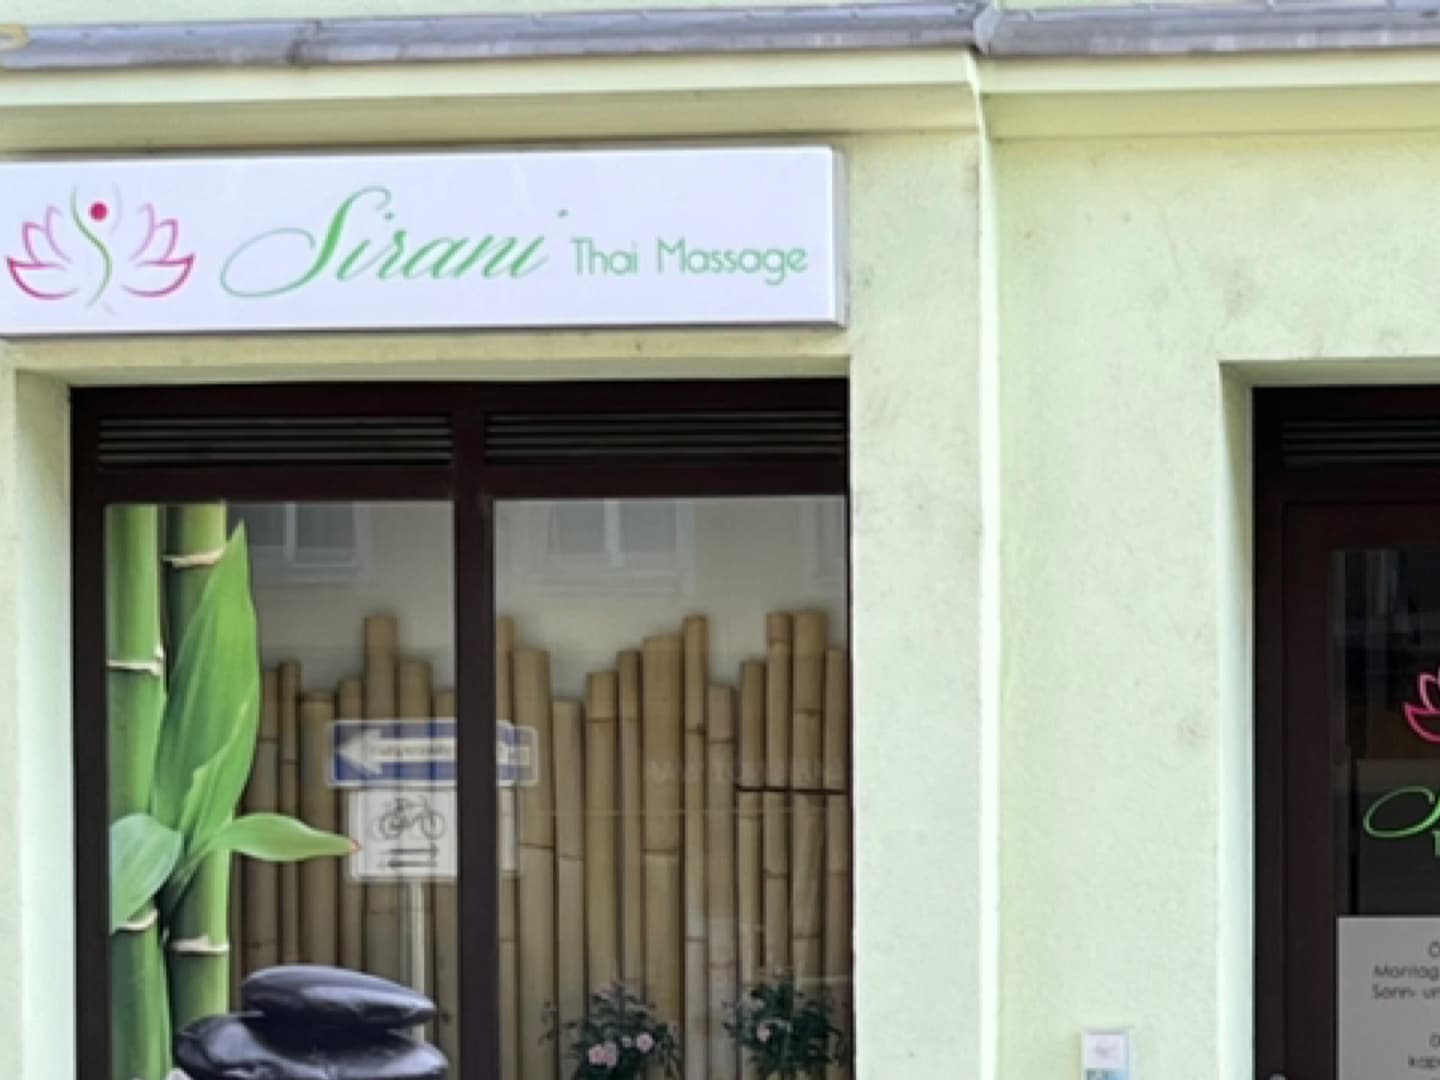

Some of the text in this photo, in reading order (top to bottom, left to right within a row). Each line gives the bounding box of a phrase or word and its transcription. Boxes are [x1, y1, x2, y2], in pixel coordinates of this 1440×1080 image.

[219, 185, 808, 299] Sirani Thai Massage
[1373, 963, 1440, 982] Montag
